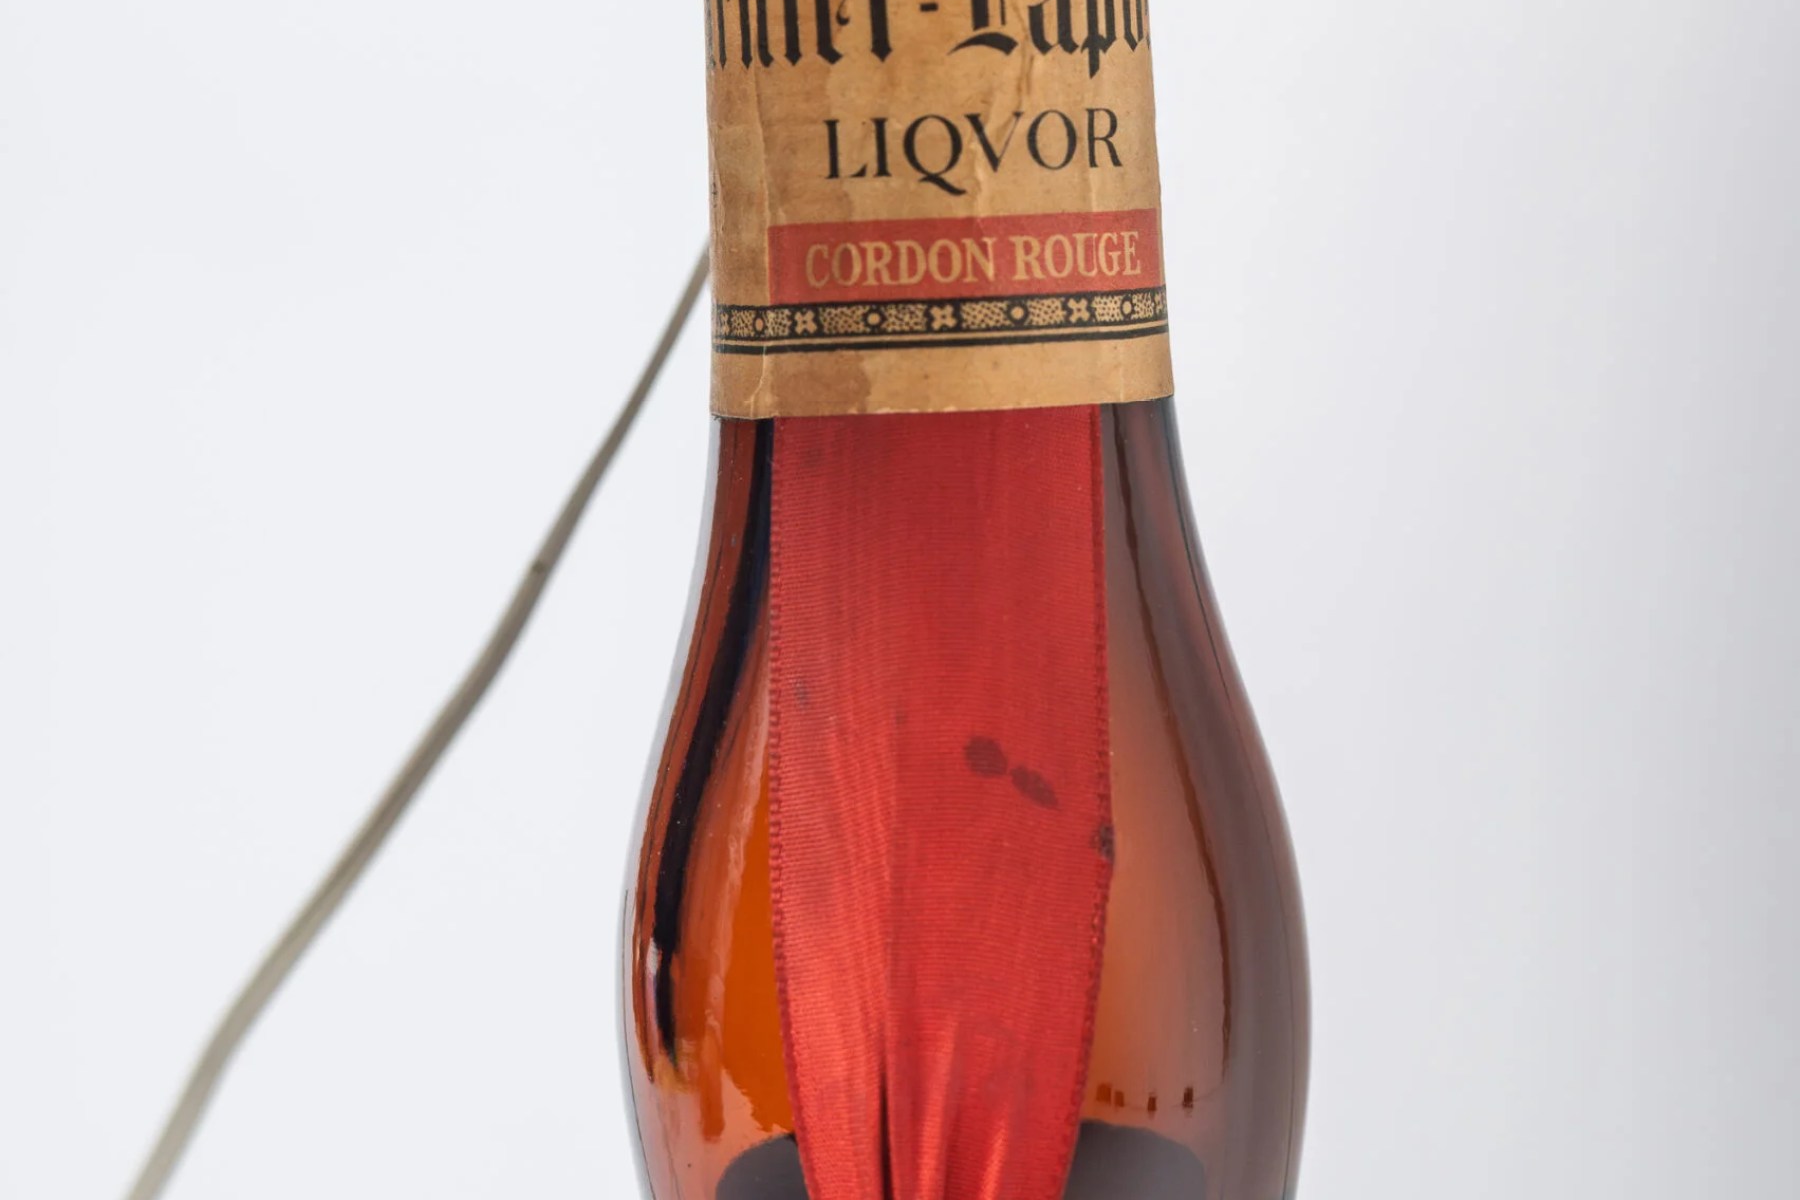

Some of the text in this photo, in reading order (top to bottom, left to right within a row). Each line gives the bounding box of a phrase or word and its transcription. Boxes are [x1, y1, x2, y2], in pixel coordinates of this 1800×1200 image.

[825, 108, 1123, 196] LIQVOR
[805, 230, 1142, 288] CORDON ROUGE
